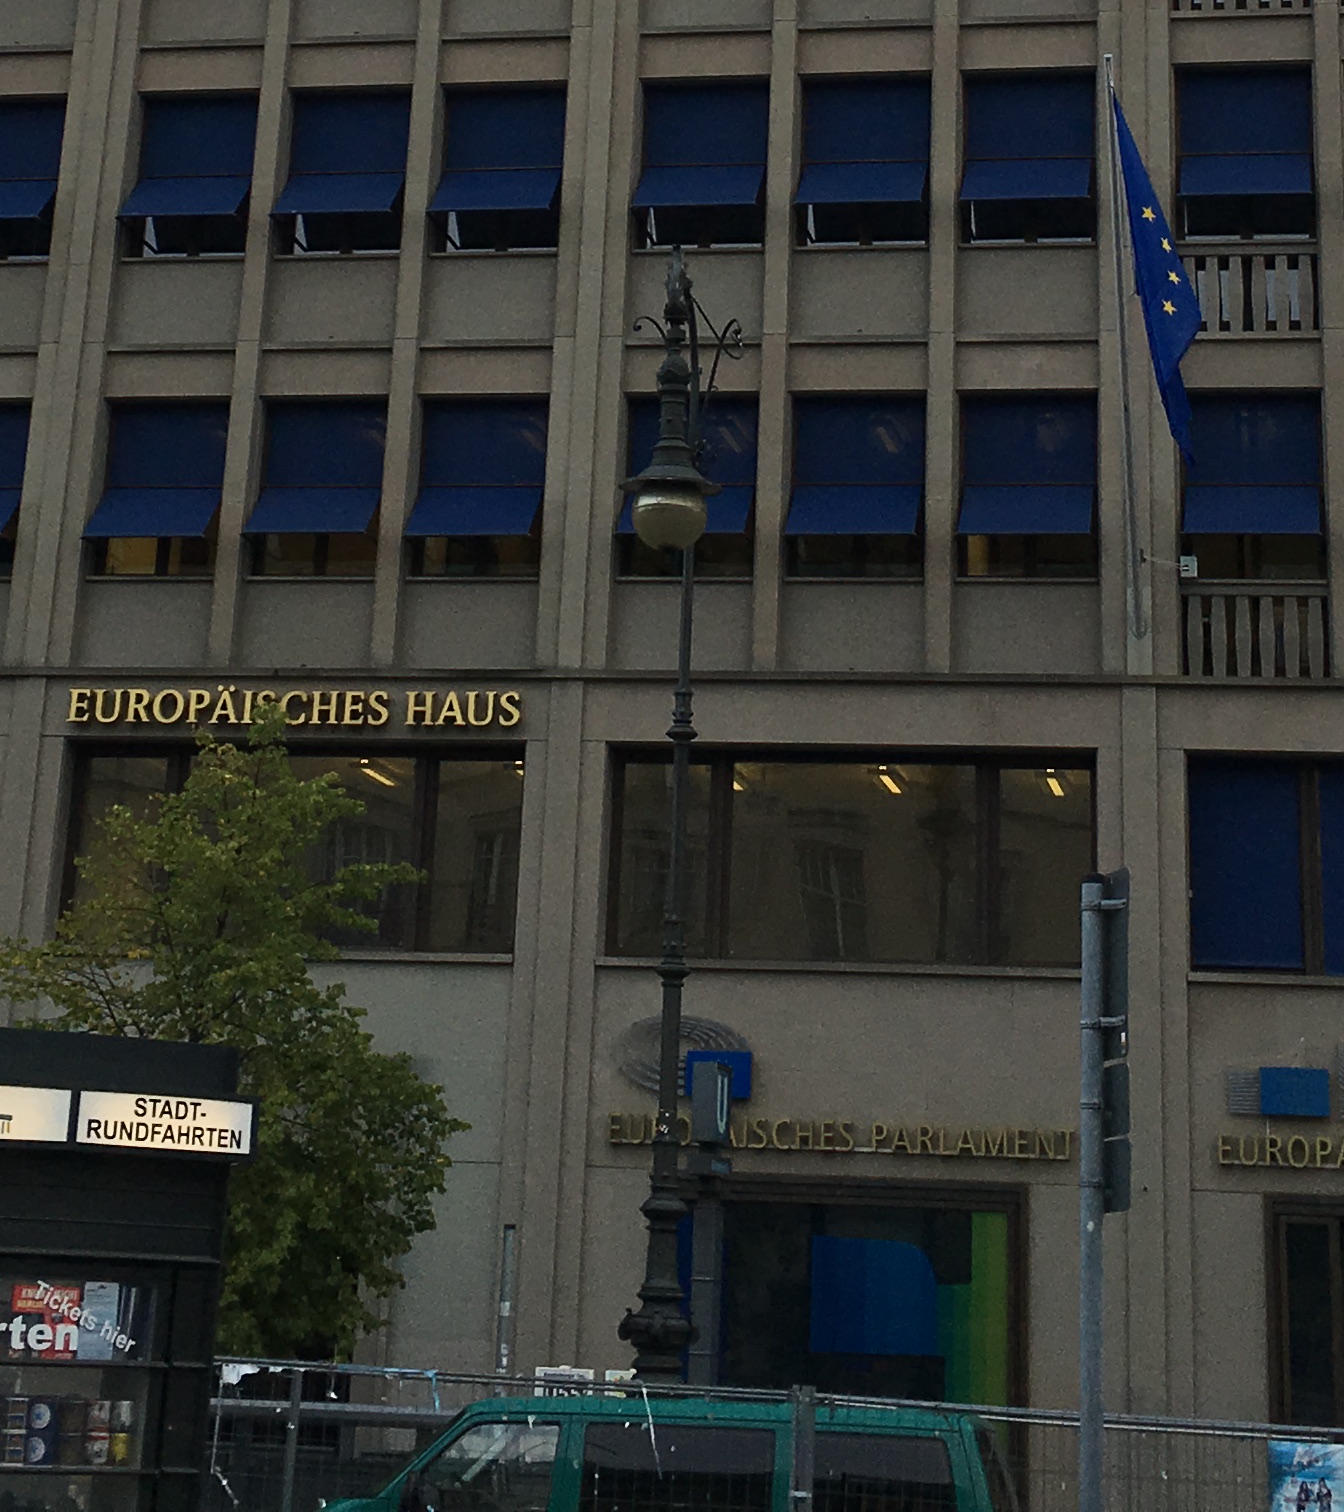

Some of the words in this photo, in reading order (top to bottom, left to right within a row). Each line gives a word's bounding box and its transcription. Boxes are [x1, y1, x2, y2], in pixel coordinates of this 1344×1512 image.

[66, 684, 389, 726] EUROPÄISCHES
[404, 690, 522, 727] HAUS
[133, 1097, 208, 1121] STADT-
[86, 1118, 243, 1150] RUNDFAHRTEN
[870, 1120, 1076, 1161] PARLAMENT
[34, 1279, 97, 1332] Tickets
[99, 1319, 137, 1354] hier
